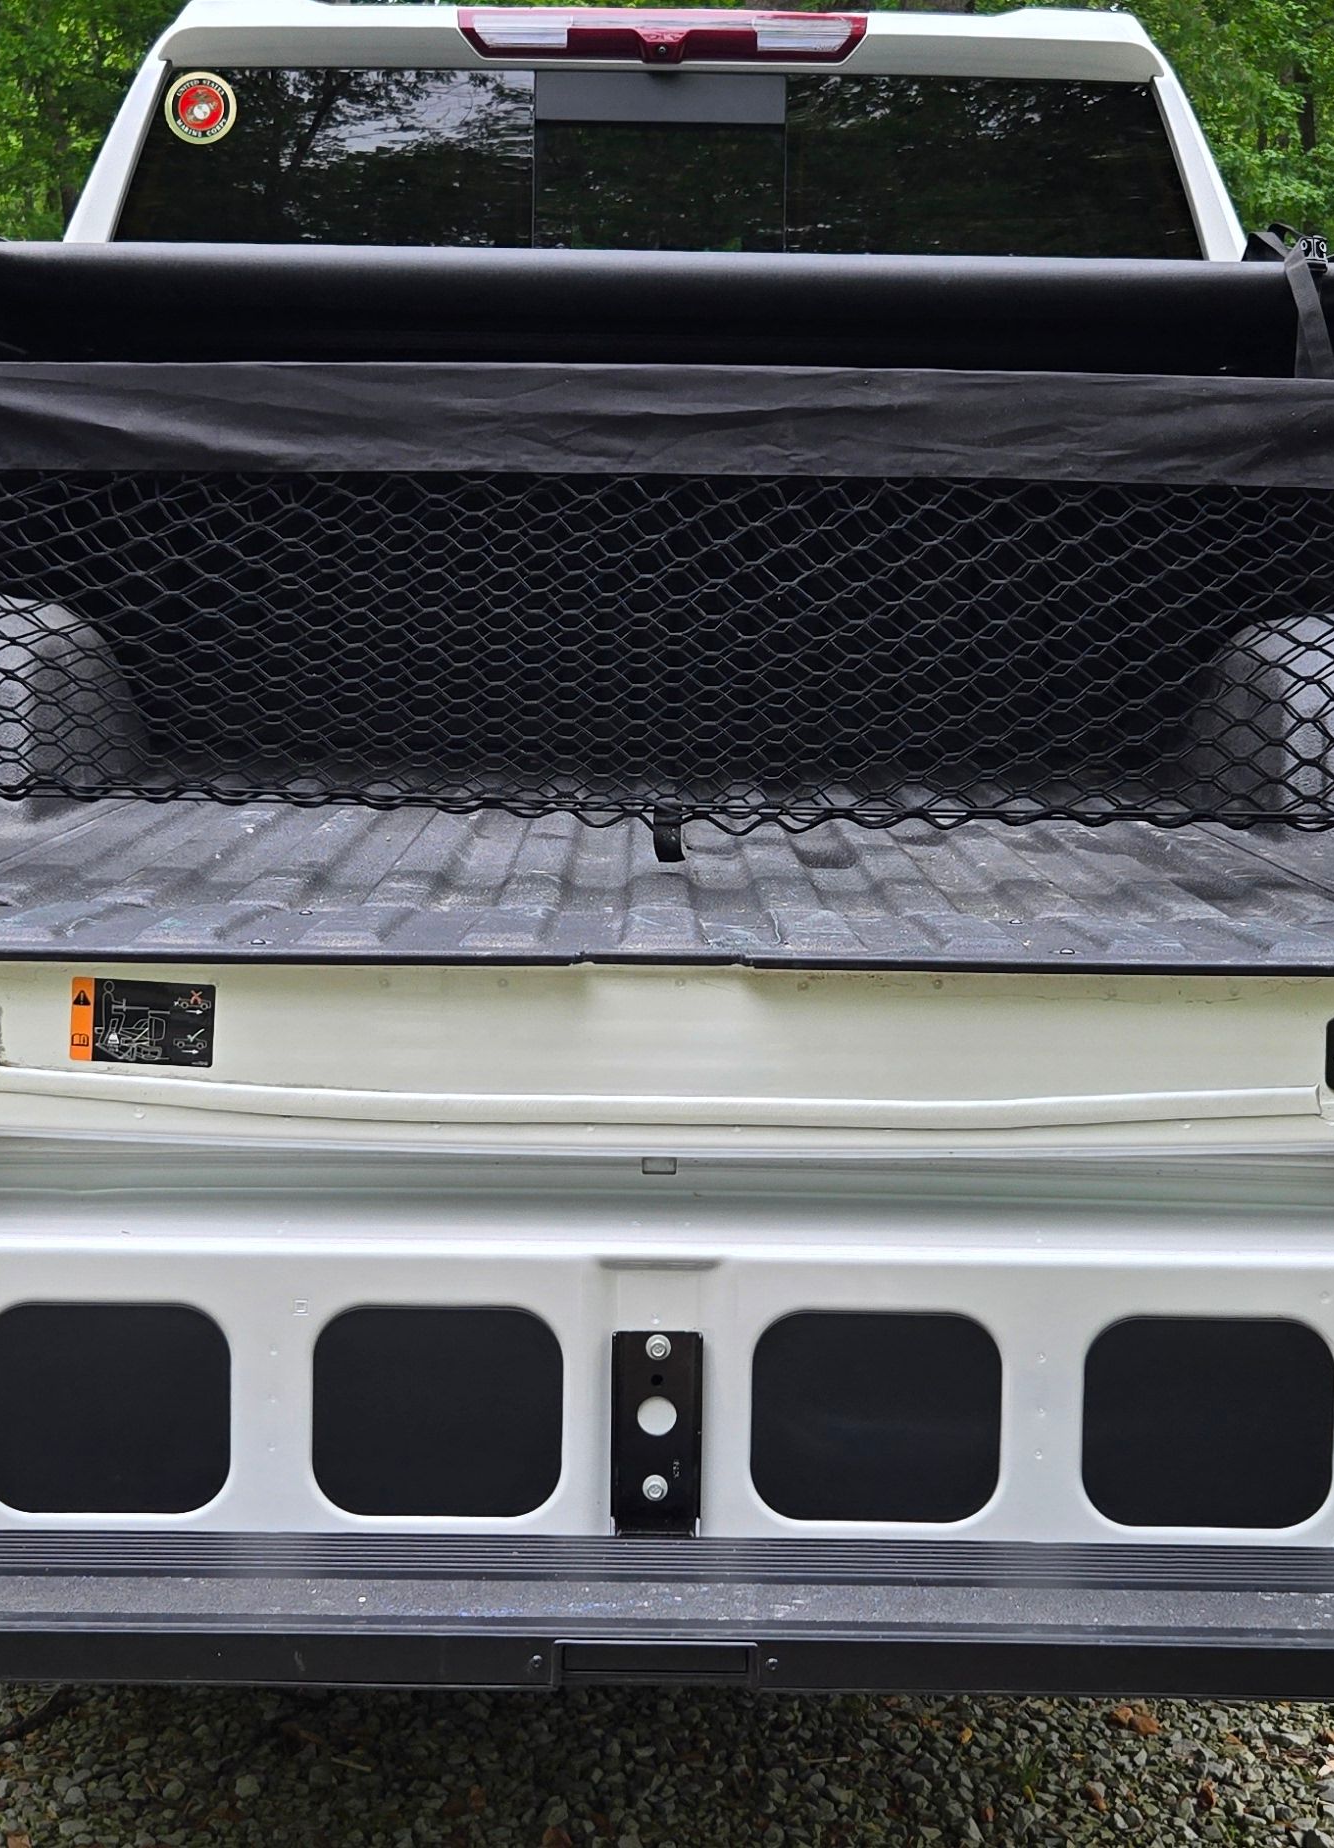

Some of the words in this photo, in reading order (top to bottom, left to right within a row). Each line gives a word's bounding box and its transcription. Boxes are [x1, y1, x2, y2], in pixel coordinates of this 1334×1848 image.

[176, 80, 200, 97] UNITED
[202, 80, 225, 96] STATES
[176, 119, 202, 138] MARINE
[206, 118, 227, 137] CORPS
